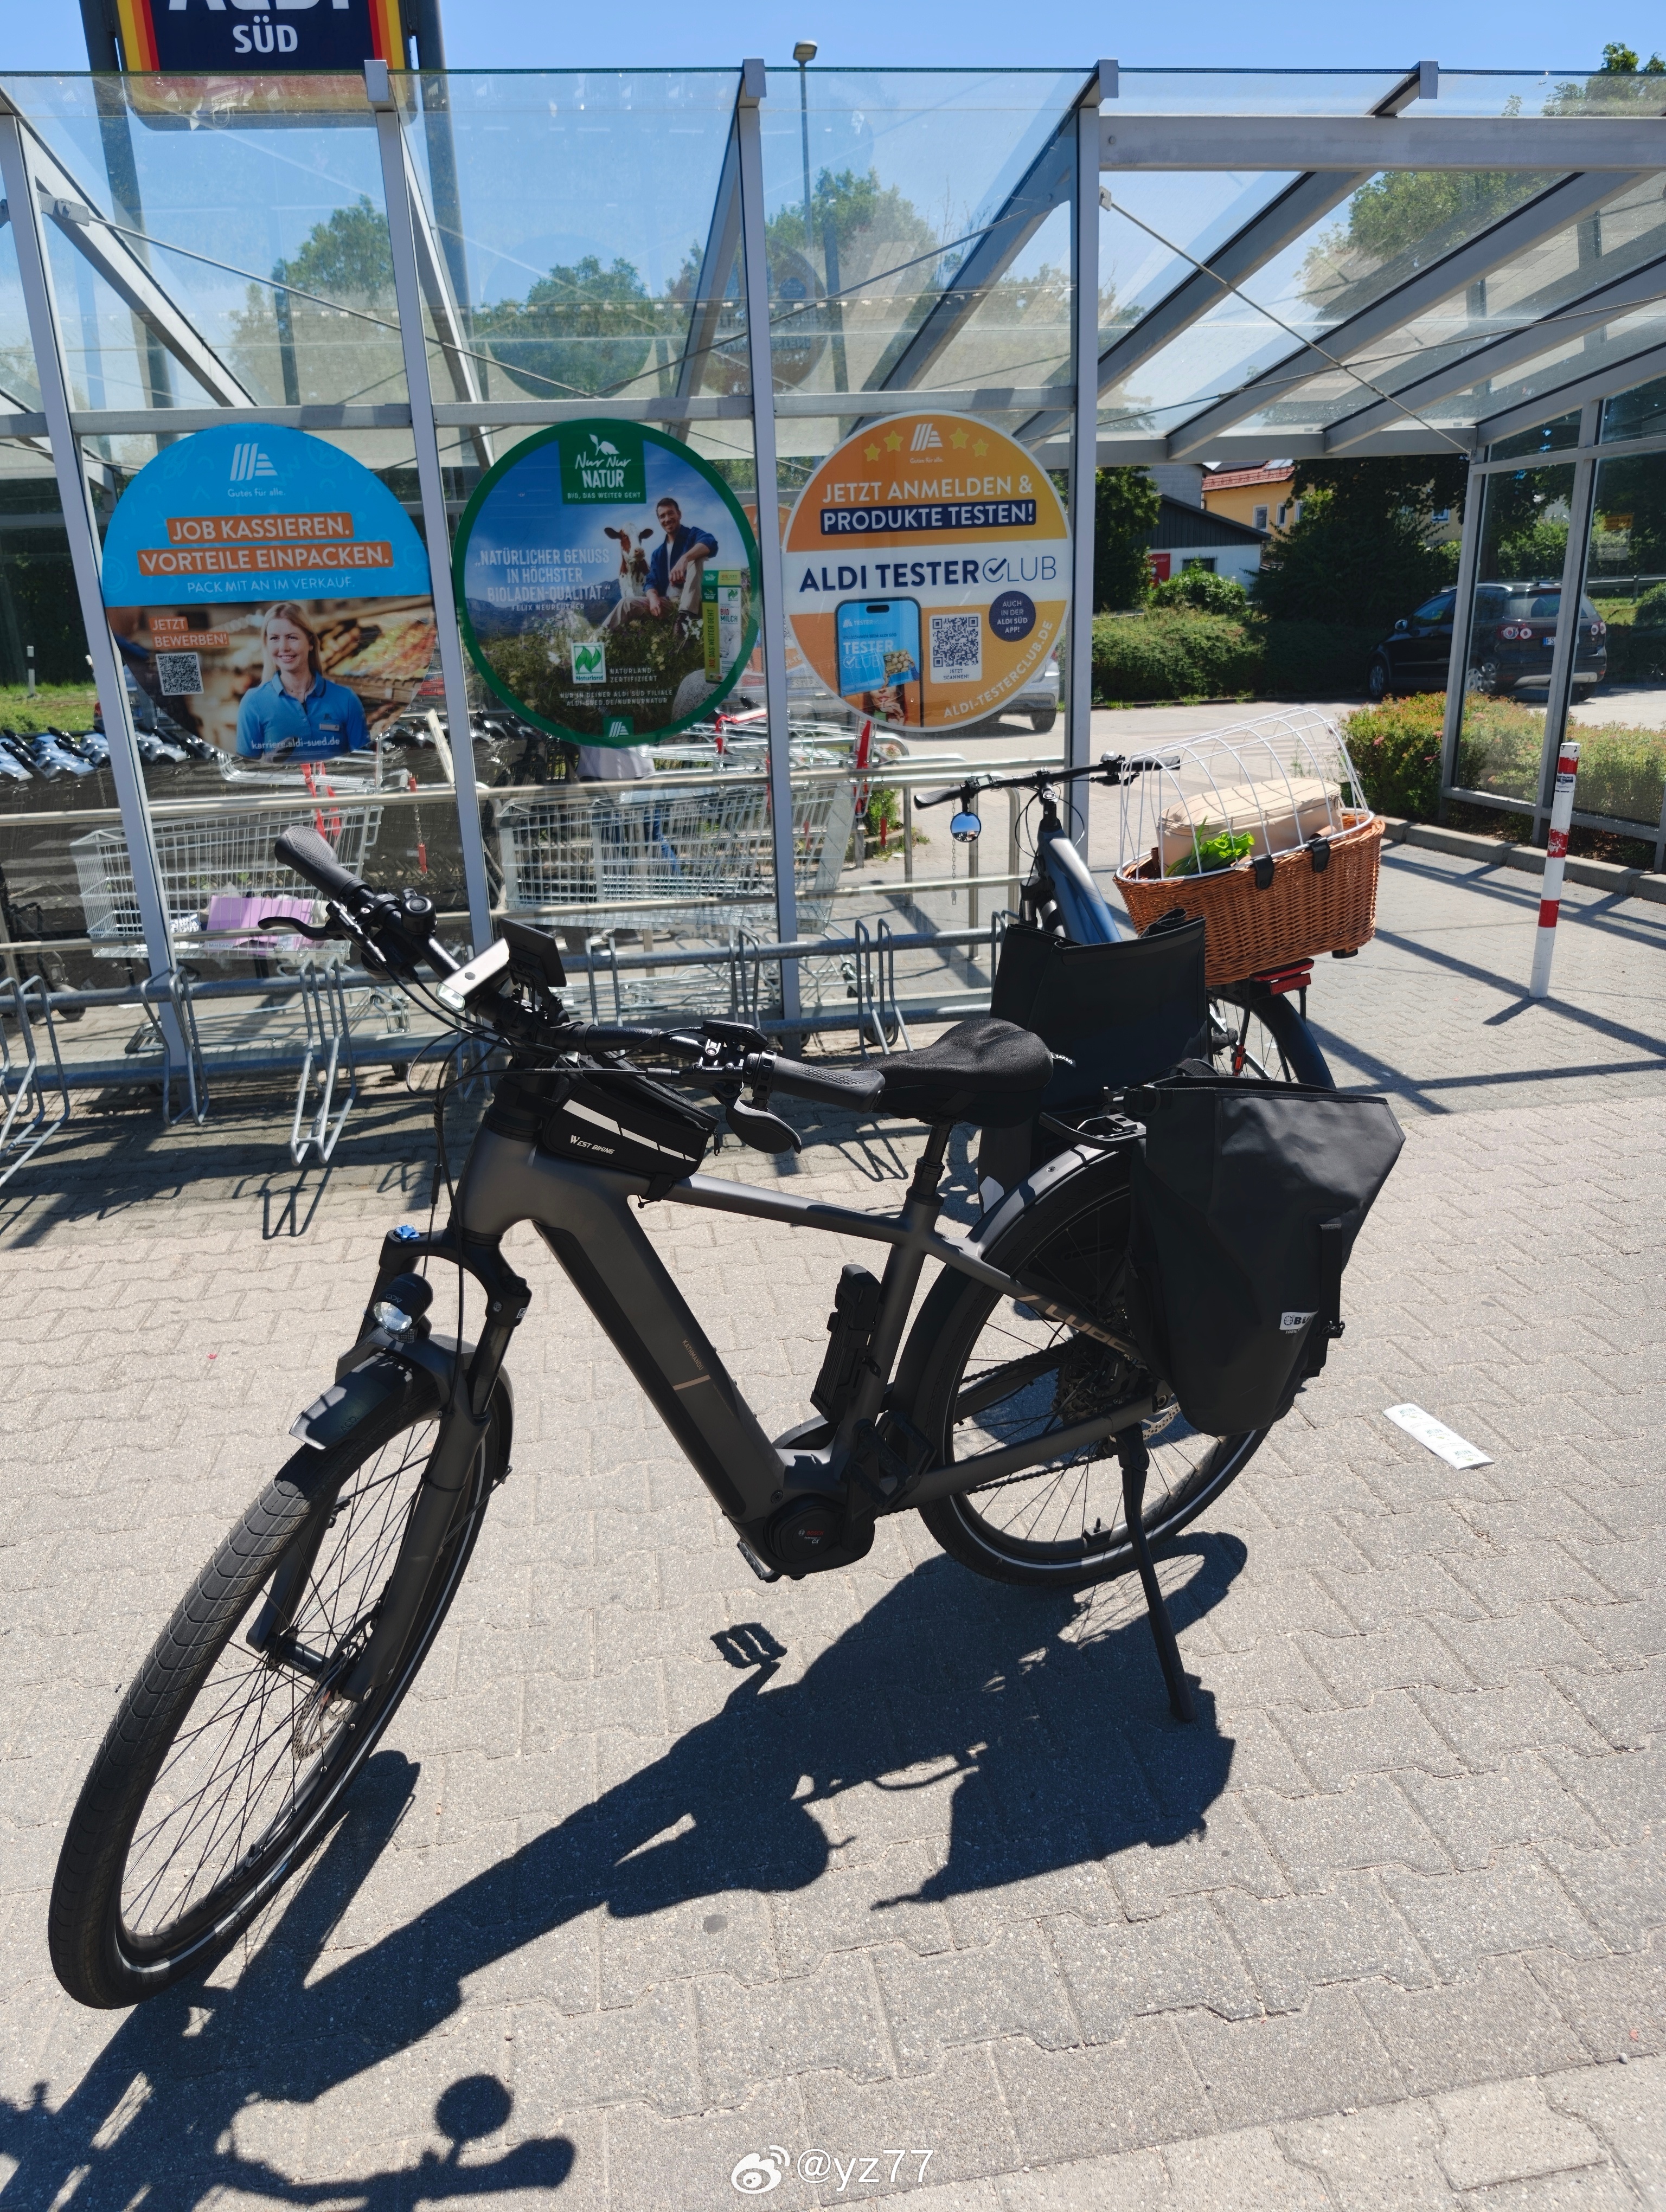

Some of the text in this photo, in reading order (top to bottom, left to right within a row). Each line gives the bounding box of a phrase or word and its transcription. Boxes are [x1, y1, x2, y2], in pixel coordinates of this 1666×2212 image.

[233, 15, 298, 53] SÜD
[575, 451, 631, 470] Nur Nur
[582, 470, 624, 488] NATUR
[227, 488, 252, 498] Gutes
[254, 488, 266, 497] für
[822, 475, 1033, 503] JETZT ANMELDEN &
[824, 504, 1034, 531] PRODUKTE TESTEN!
[173, 517, 350, 541] JOB KASSIEREN.
[140, 546, 389, 572] VORTEILE EINPACKEN.
[564, 549, 610, 564] GENUSS
[507, 565, 583, 584] IN HÖCHSTER
[799, 565, 867, 593] ALDI
[188, 576, 355, 593] PACK MIT AN IM VERKAUF.
[151, 618, 185, 631] JETZT
[1014, 616, 1028, 625] SÜD
[154, 633, 228, 648] BEWERBEN!
[843, 640, 894, 654] TESTER
[943, 620, 1053, 719] ALDI-TESTERCLUB.DE
[252, 737, 340, 750] karriere.aldi-sued.de
[570, 1135, 615, 1154] WEST BIKING
[682, 1339, 704, 1371] KATHMANDU
